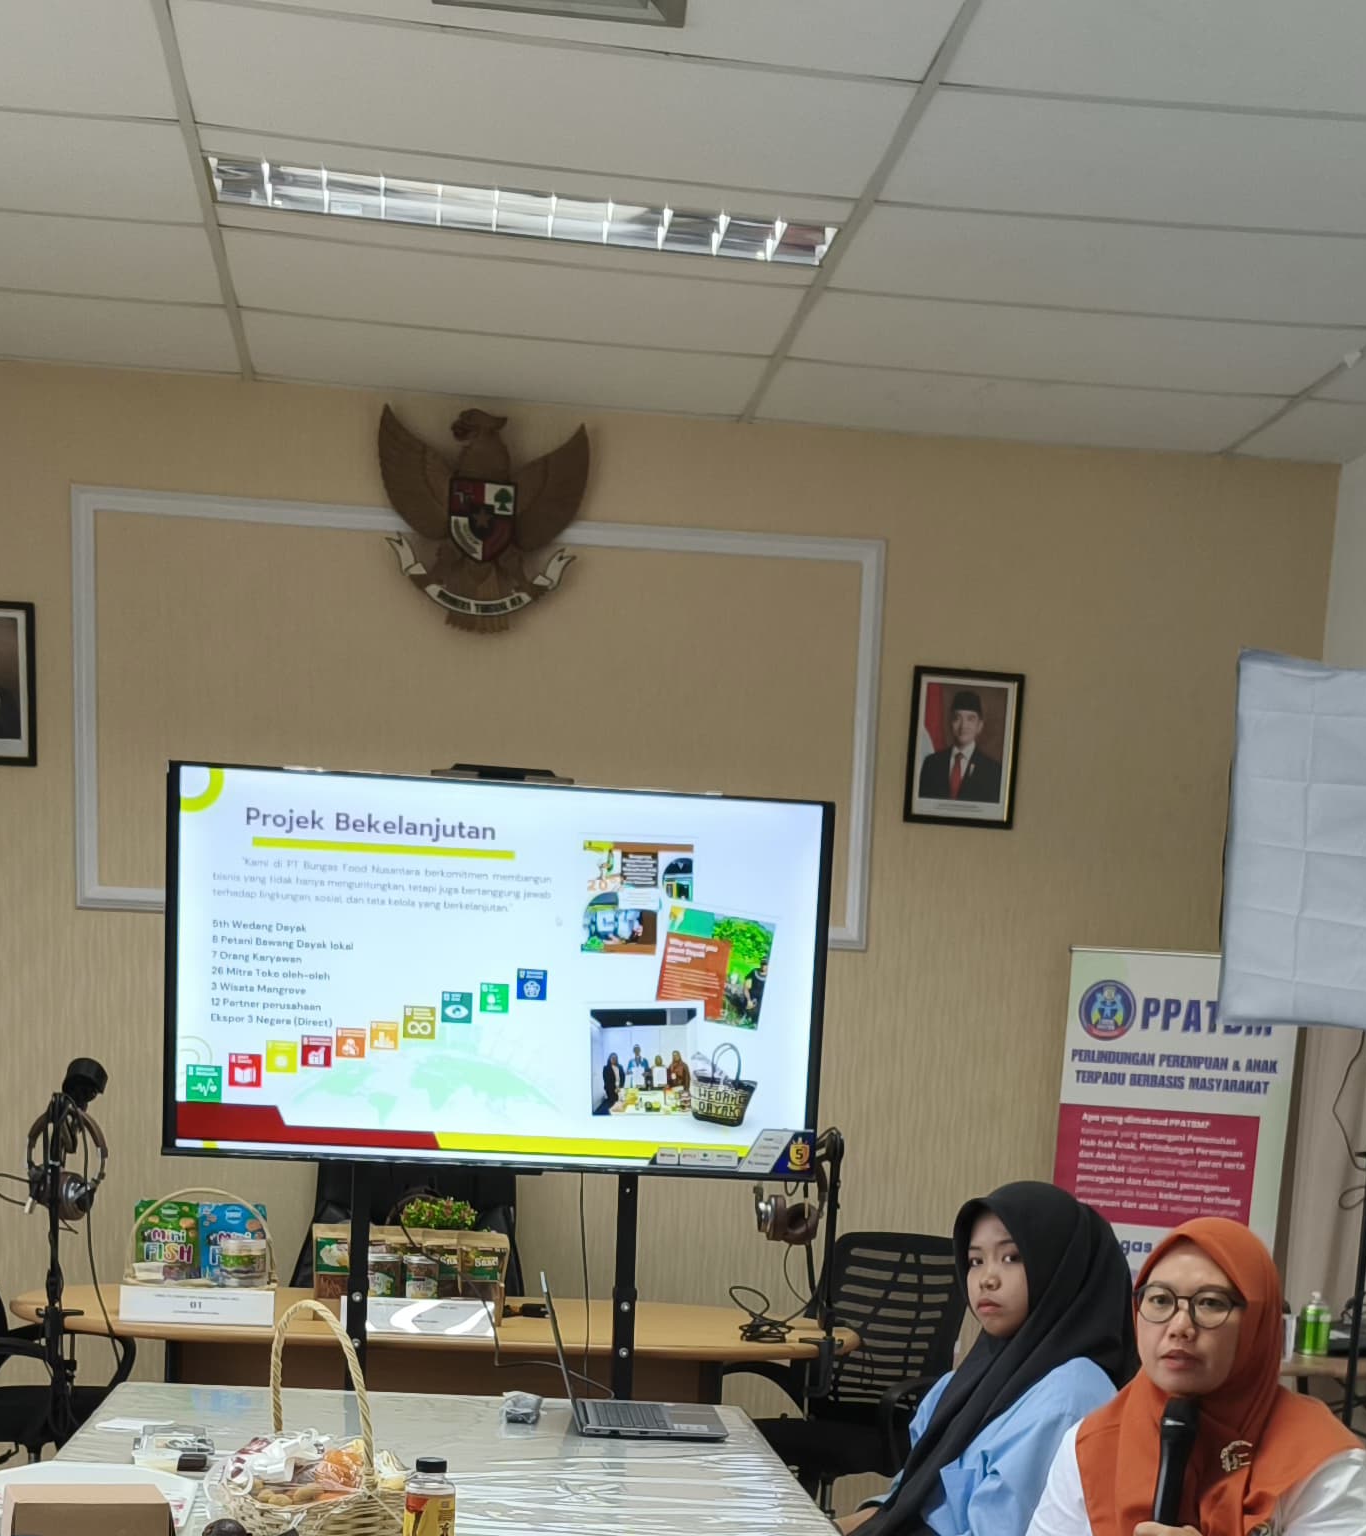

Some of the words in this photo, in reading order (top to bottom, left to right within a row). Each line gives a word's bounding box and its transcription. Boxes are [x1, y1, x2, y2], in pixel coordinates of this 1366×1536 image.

[246, 807, 324, 833] Projek
[335, 813, 496, 843] Bekelanjutan
[213, 920, 229, 929] 5th
[232, 921, 273, 933] Wedang
[276, 924, 307, 934] Dayak
[221, 936, 253, 946] Petani
[256, 938, 293, 950] Bawang
[296, 940, 327, 951] Dayak
[331, 941, 353, 950] lokal
[212, 951, 217, 959] 7
[220, 951, 250, 963] Orang
[253, 953, 302, 965] Karyawan
[212, 967, 223, 976] 26
[226, 967, 253, 977] Mitra
[256, 969, 279, 978] Toko
[282, 971, 330, 981] oleh-oleh
[211, 983, 217, 991] 3
[220, 983, 255, 993] Wisata
[257, 986, 306, 997] Mangrove
[211, 998, 220, 1007] 12
[223, 999, 259, 1010] Partner
[262, 1002, 321, 1014] perusahaan
[211, 1014, 244, 1026] Ekspor
[248, 1015, 253, 1024] 3
[256, 1016, 291, 1029] Negara
[294, 1017, 332, 1029] (Direct)
[1071, 1049, 1155, 1066] PERLINDUNGAN
[1159, 1054, 1228, 1071] PEREMPUAN
[1245, 1059, 1277, 1074] ANAK
[1075, 1070, 1125, 1086] TERPADU
[1129, 1073, 1184, 1090] BERBASIS
[1188, 1078, 1269, 1094] MASYARAKAT
[144, 1243, 193, 1264] FISH
